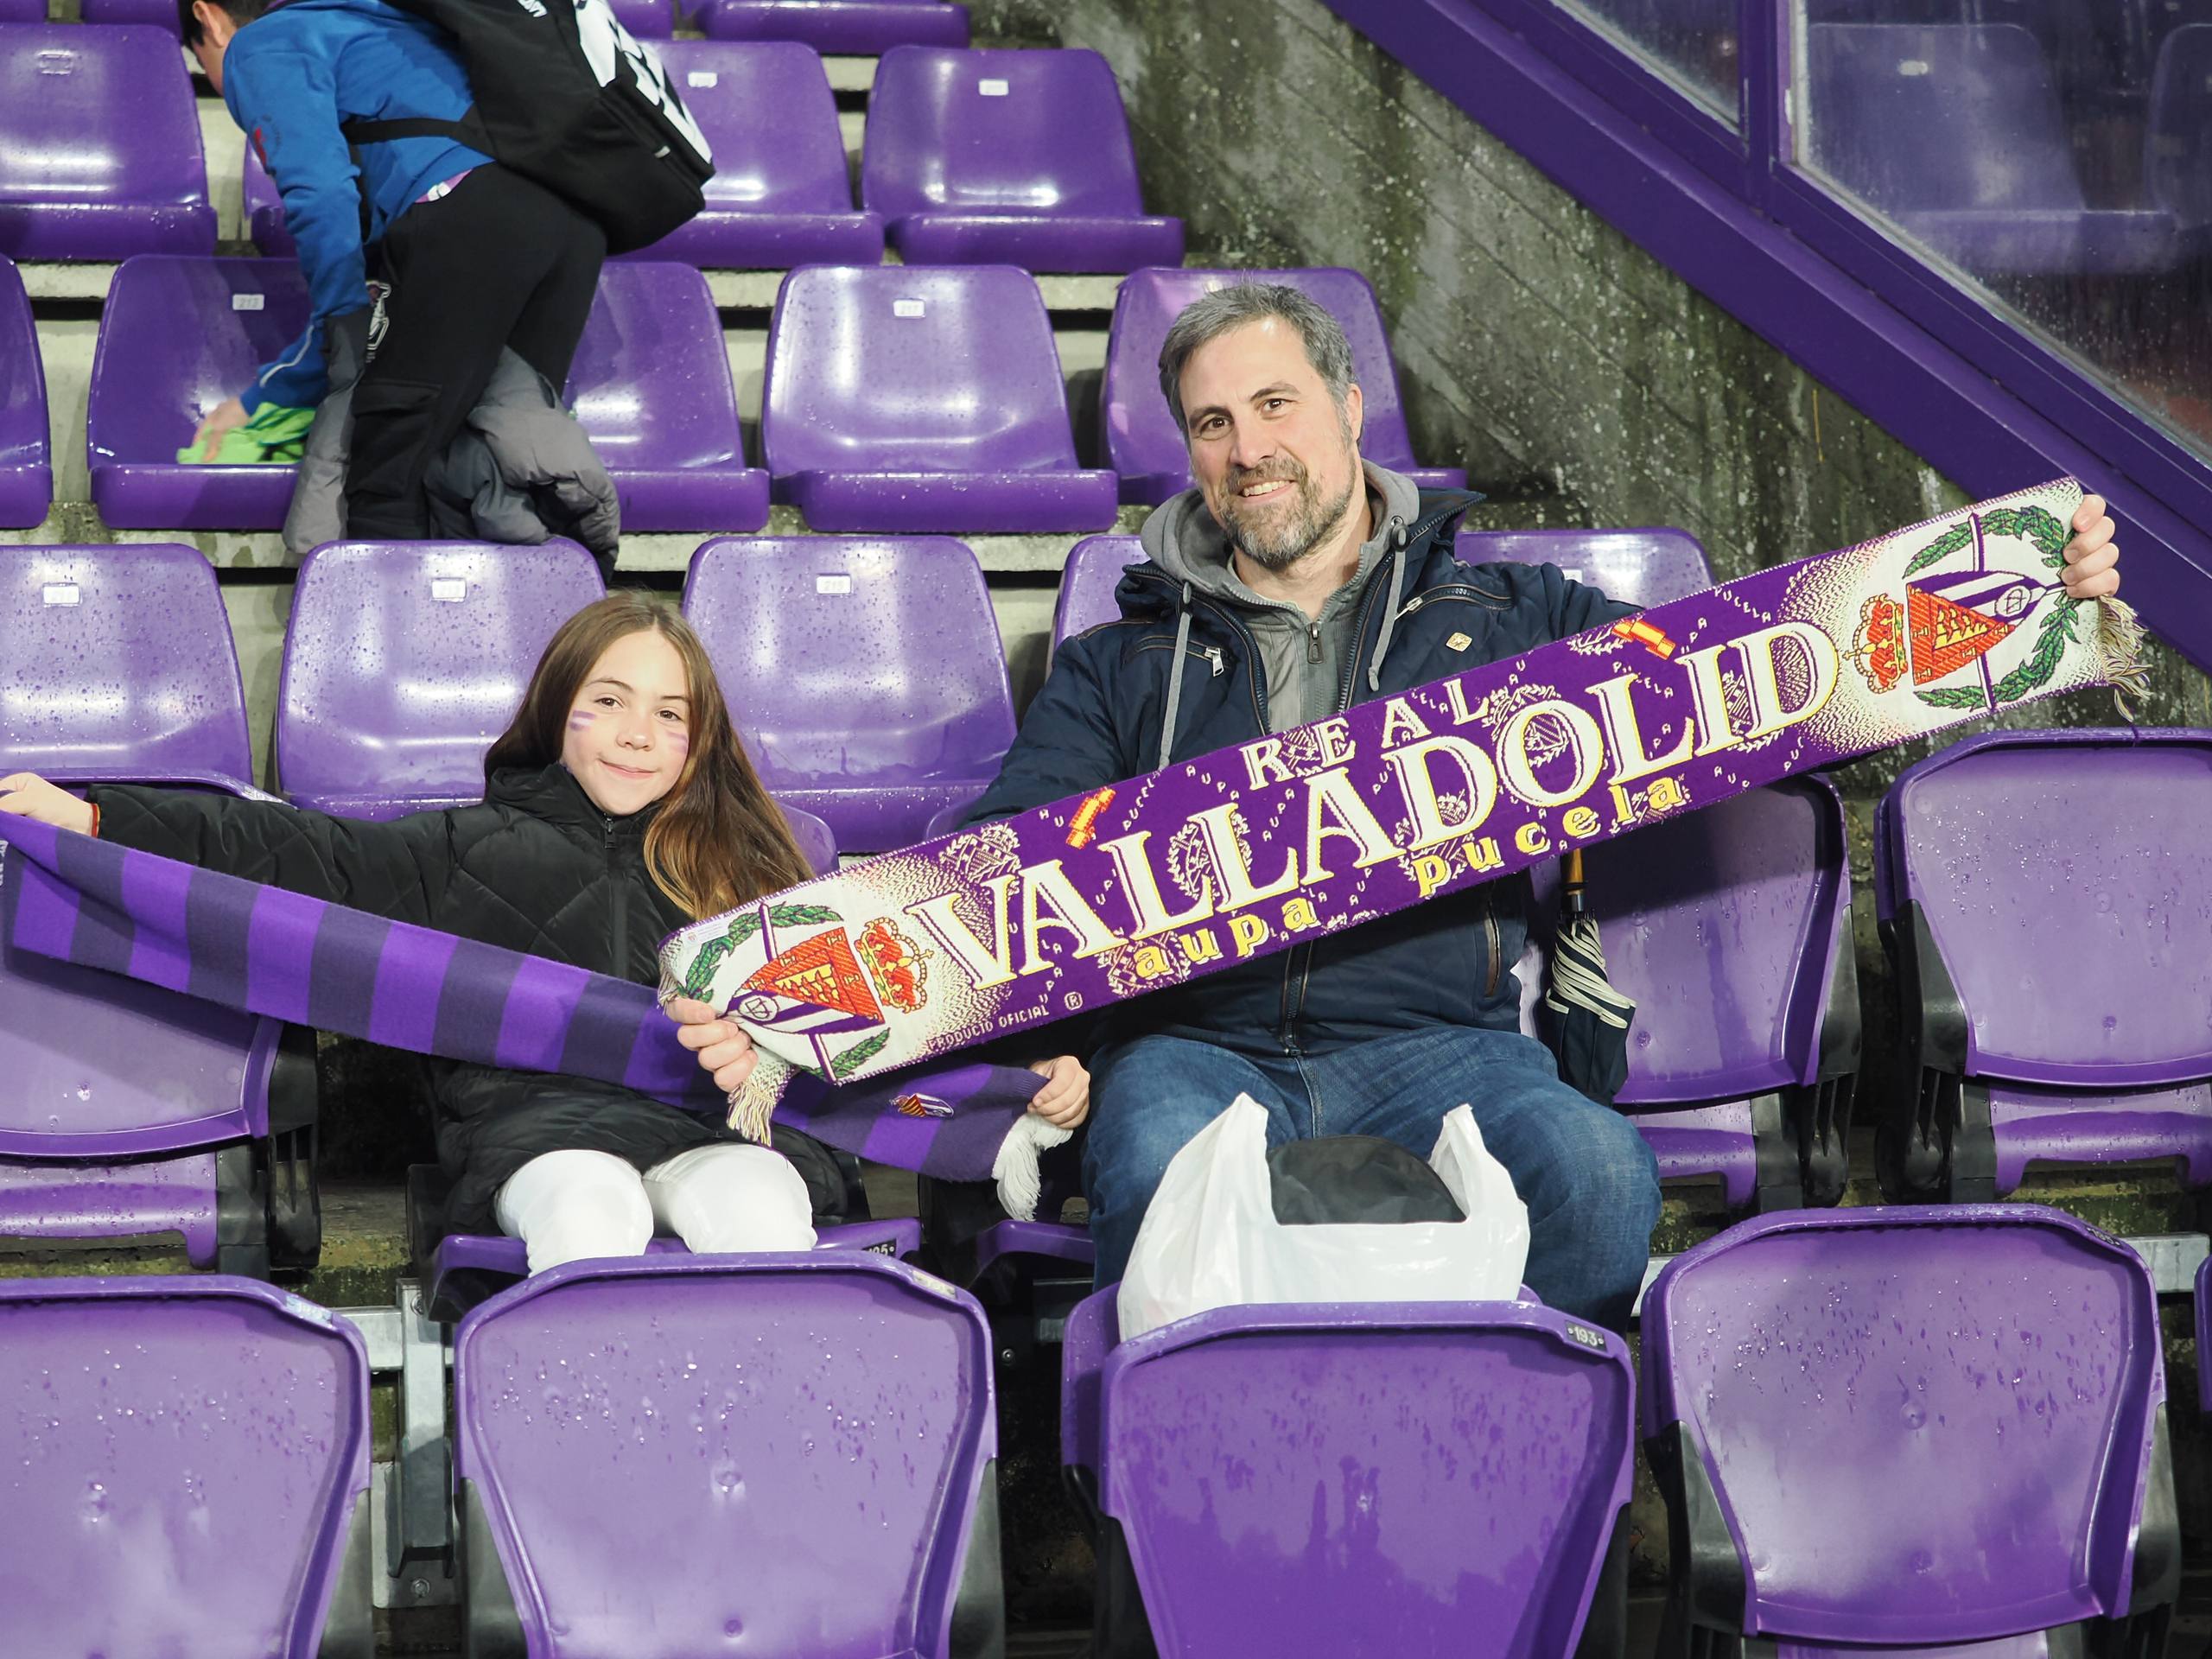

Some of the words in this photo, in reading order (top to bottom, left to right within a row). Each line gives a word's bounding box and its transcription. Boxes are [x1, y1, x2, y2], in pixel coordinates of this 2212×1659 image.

[1714, 588, 1771, 622] PUCELA
[1239, 678, 1490, 791] REAL
[1186, 765, 1240, 800] AUPA
[905, 621, 1839, 990] VALLADOLID
[1262, 788, 1295, 842] AUPA
[1135, 897, 1321, 980] aupa
[1412, 777, 1686, 899] pucela
[998, 1004, 1049, 1028] OFICIAL
[1574, 1326, 1598, 1346] 193
